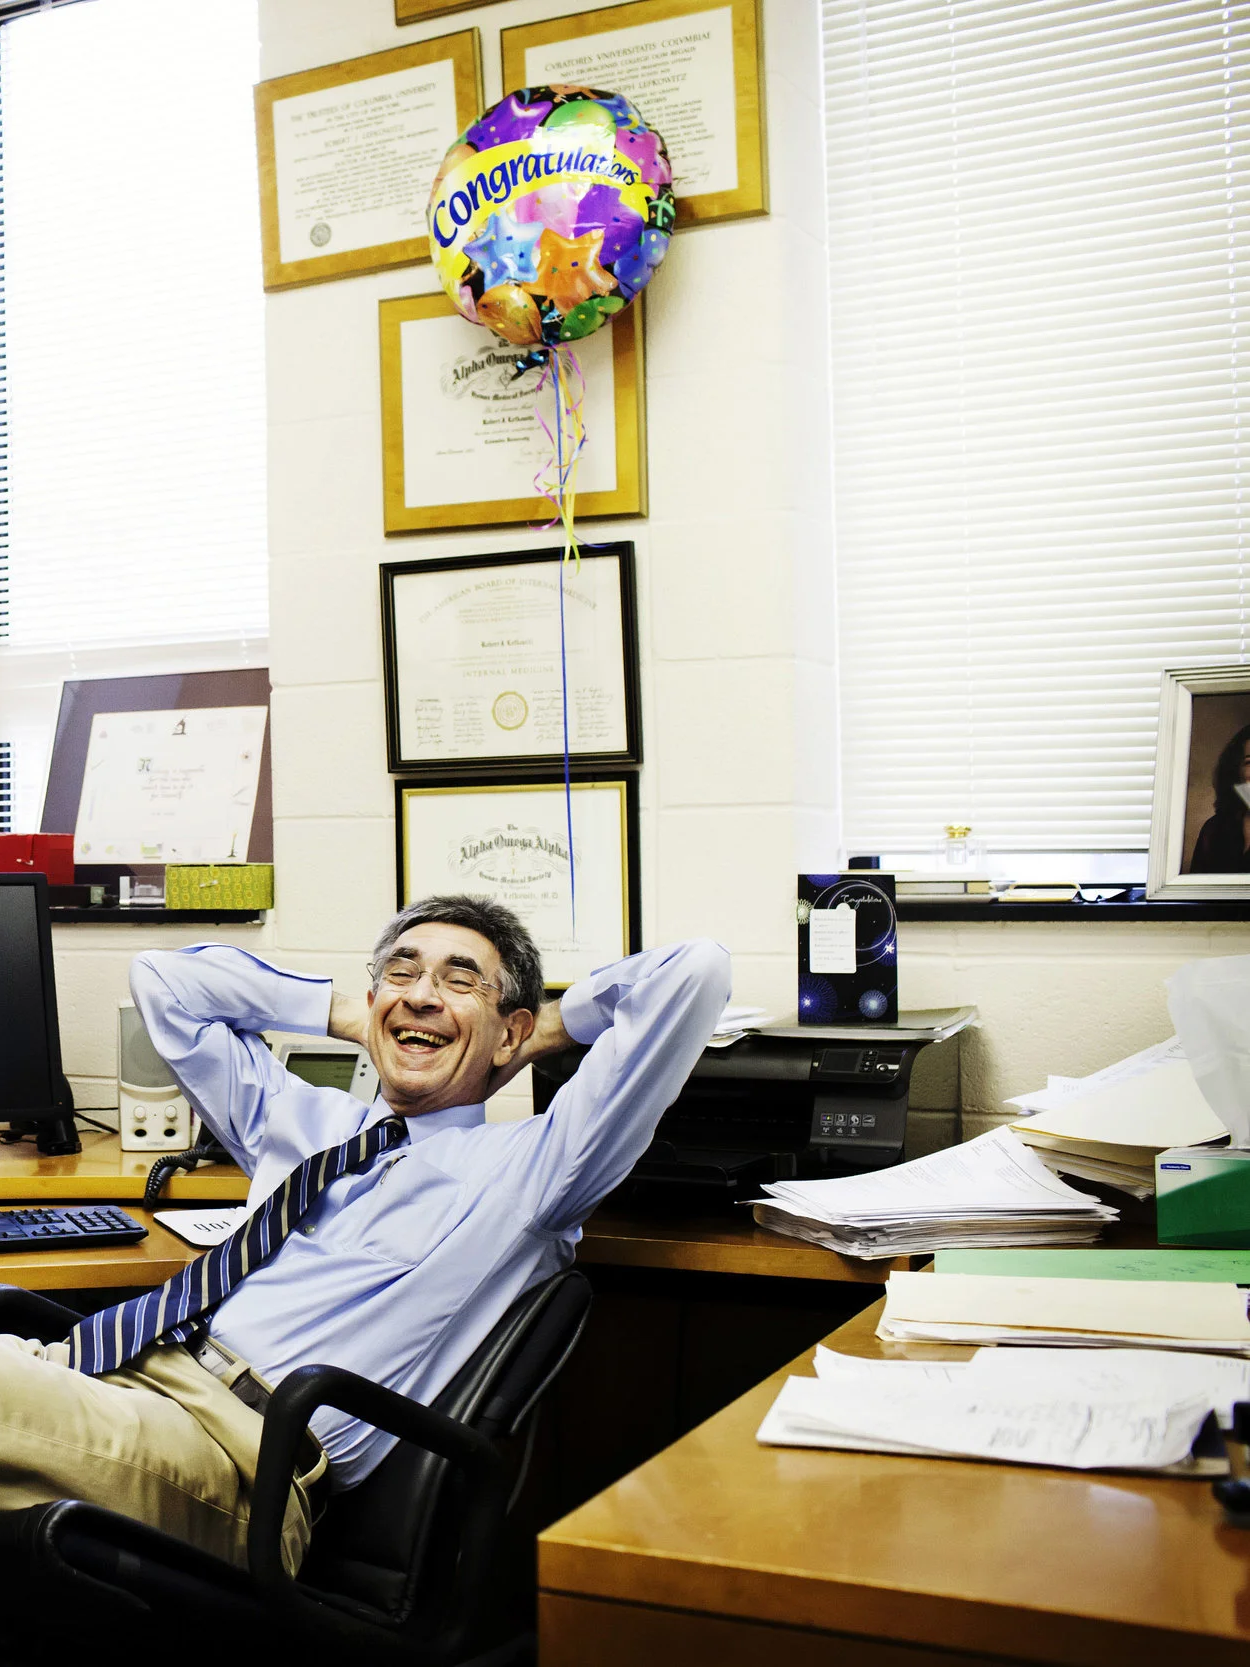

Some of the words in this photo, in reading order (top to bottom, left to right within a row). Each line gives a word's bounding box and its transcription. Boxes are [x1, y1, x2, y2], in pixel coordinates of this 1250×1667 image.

[433, 146, 638, 248] Congratulations
[452, 360, 486, 384] Alpha
[460, 840, 494, 864] Alpha
[494, 834, 532, 851] Omega
[536, 835, 568, 860] Alpha
